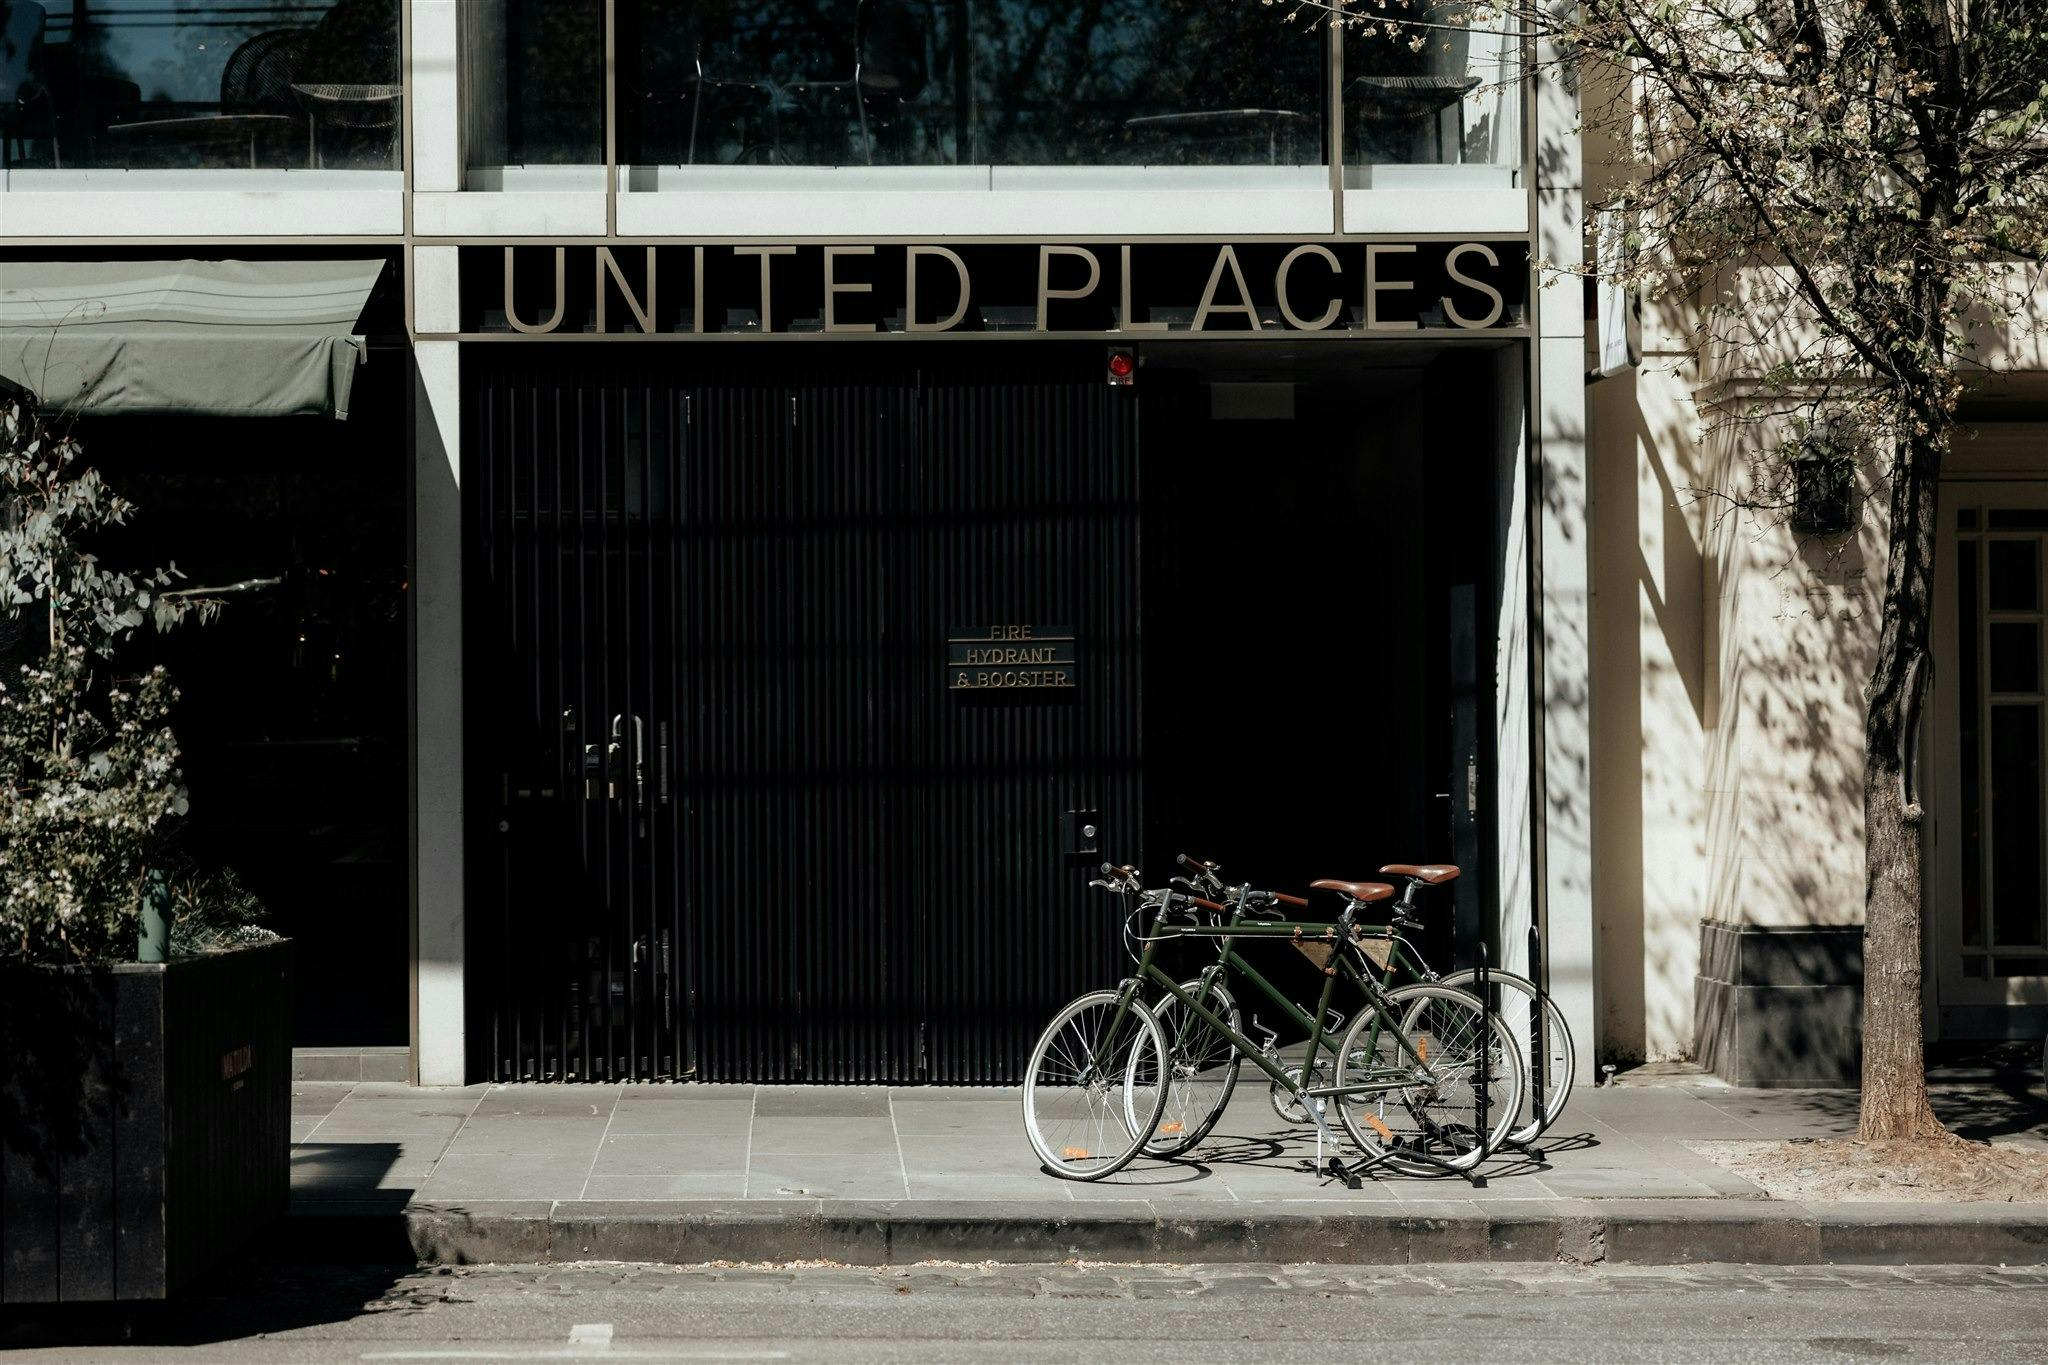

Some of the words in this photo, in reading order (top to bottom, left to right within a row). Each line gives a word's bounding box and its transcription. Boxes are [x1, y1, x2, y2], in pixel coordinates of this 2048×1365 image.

[504, 245, 971, 334] UNITED
[1036, 243, 1504, 331] PLACES
[990, 625, 1032, 640] FIRE
[966, 647, 1056, 663] HYDRANT
[957, 672, 971, 687] &
[977, 671, 1067, 687] BOOSTER
